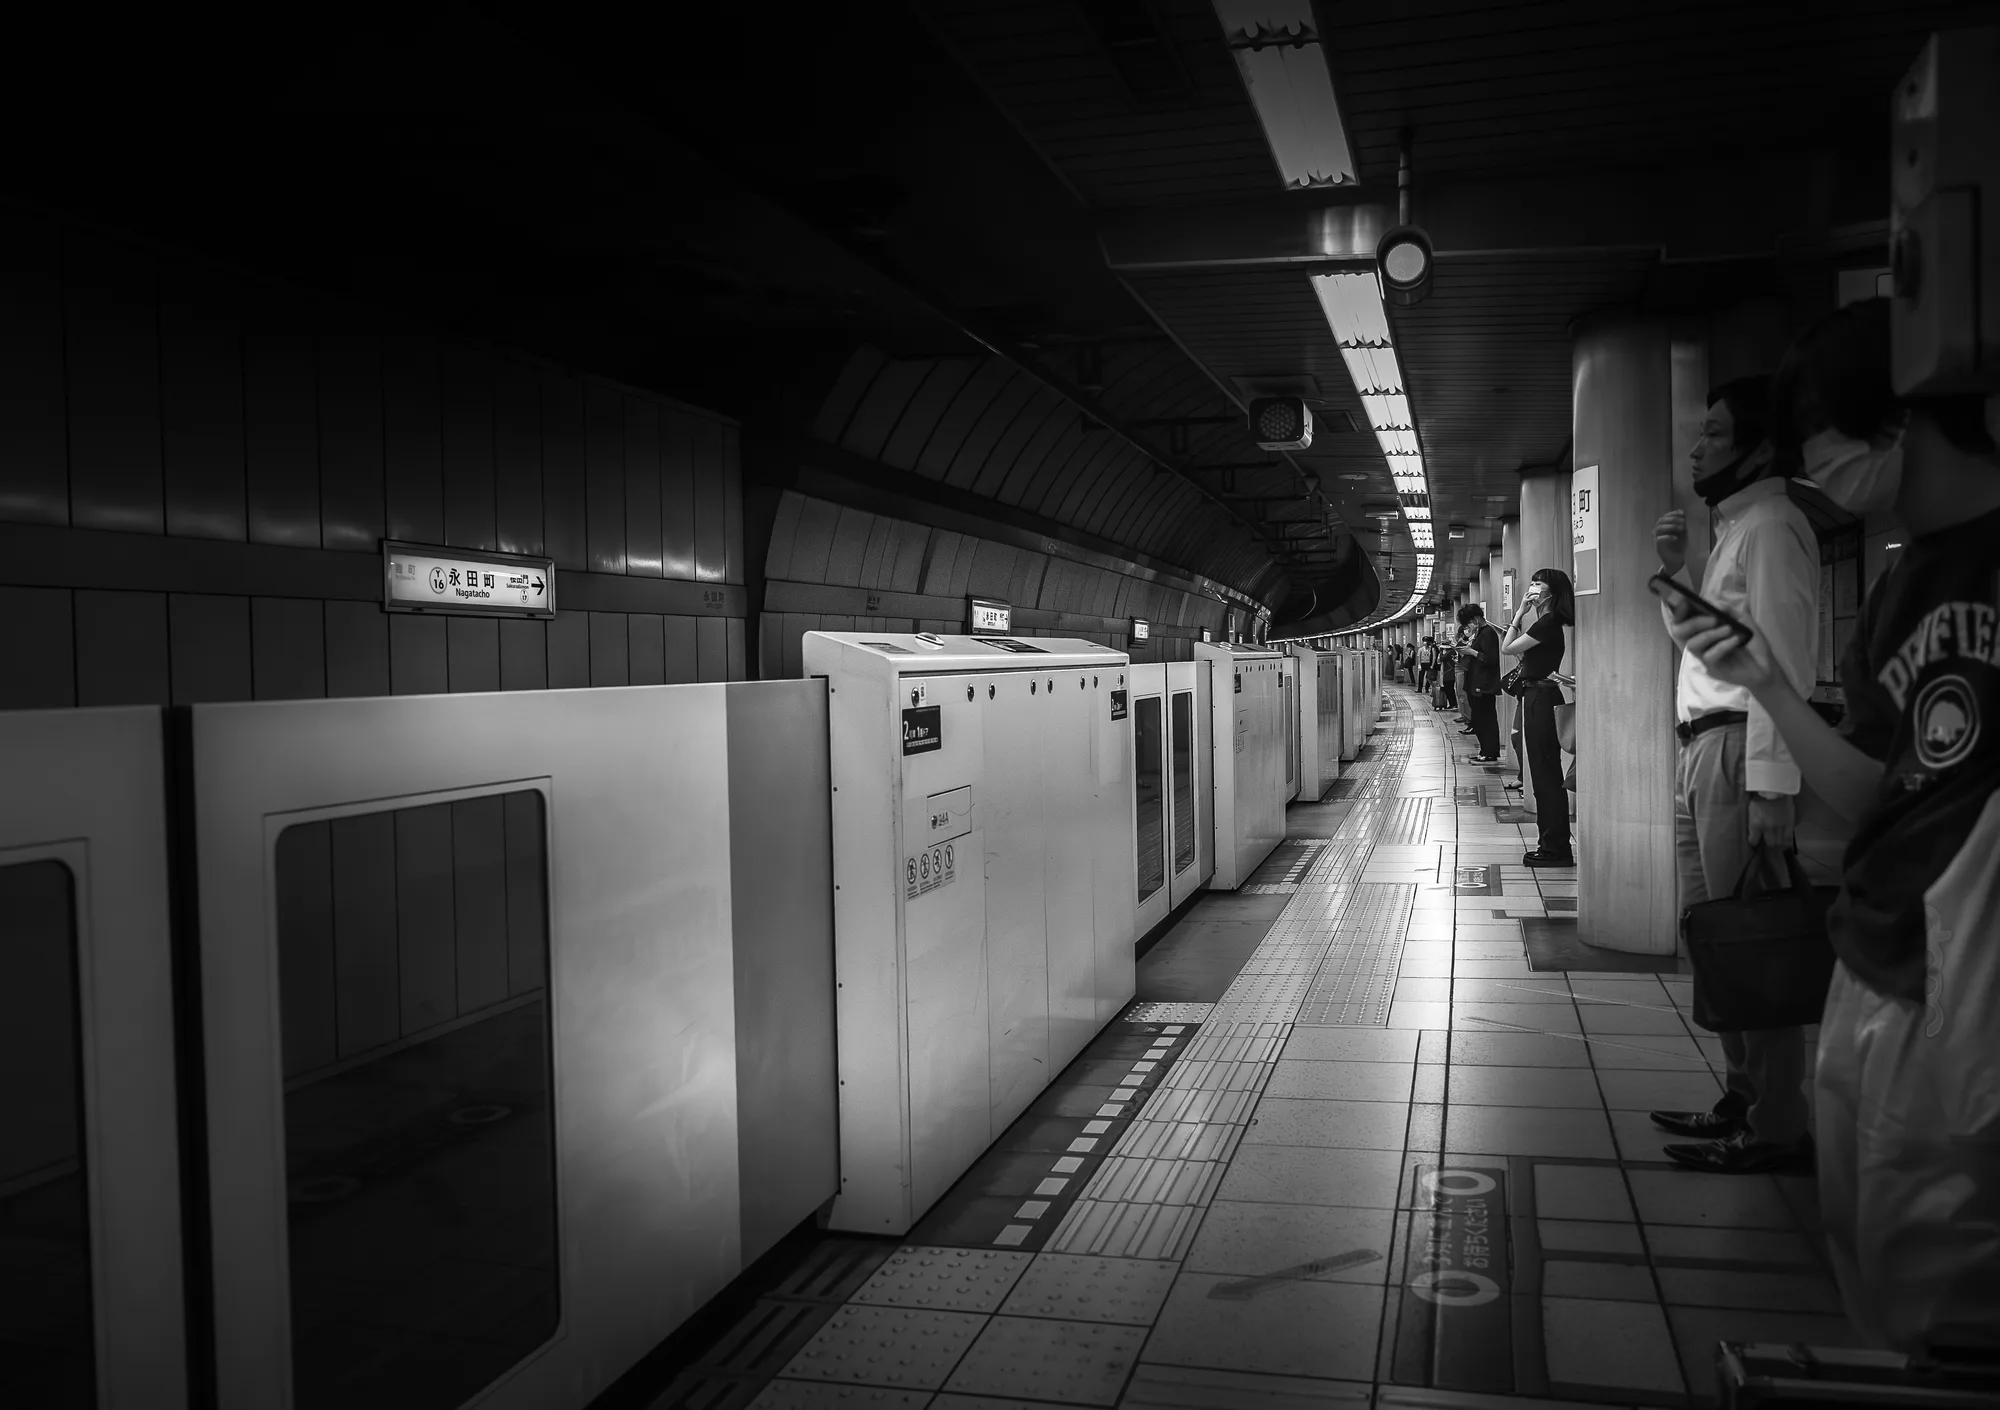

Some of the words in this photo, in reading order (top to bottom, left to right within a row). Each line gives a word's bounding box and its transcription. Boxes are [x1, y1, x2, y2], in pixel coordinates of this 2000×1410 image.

[435, 569, 441, 578] Y
[449, 568, 495, 589] 永田町
[433, 579, 445, 590] 16
[455, 587, 491, 600] Nagatacho
[1462, 1198, 1490, 1269] お待ちください
